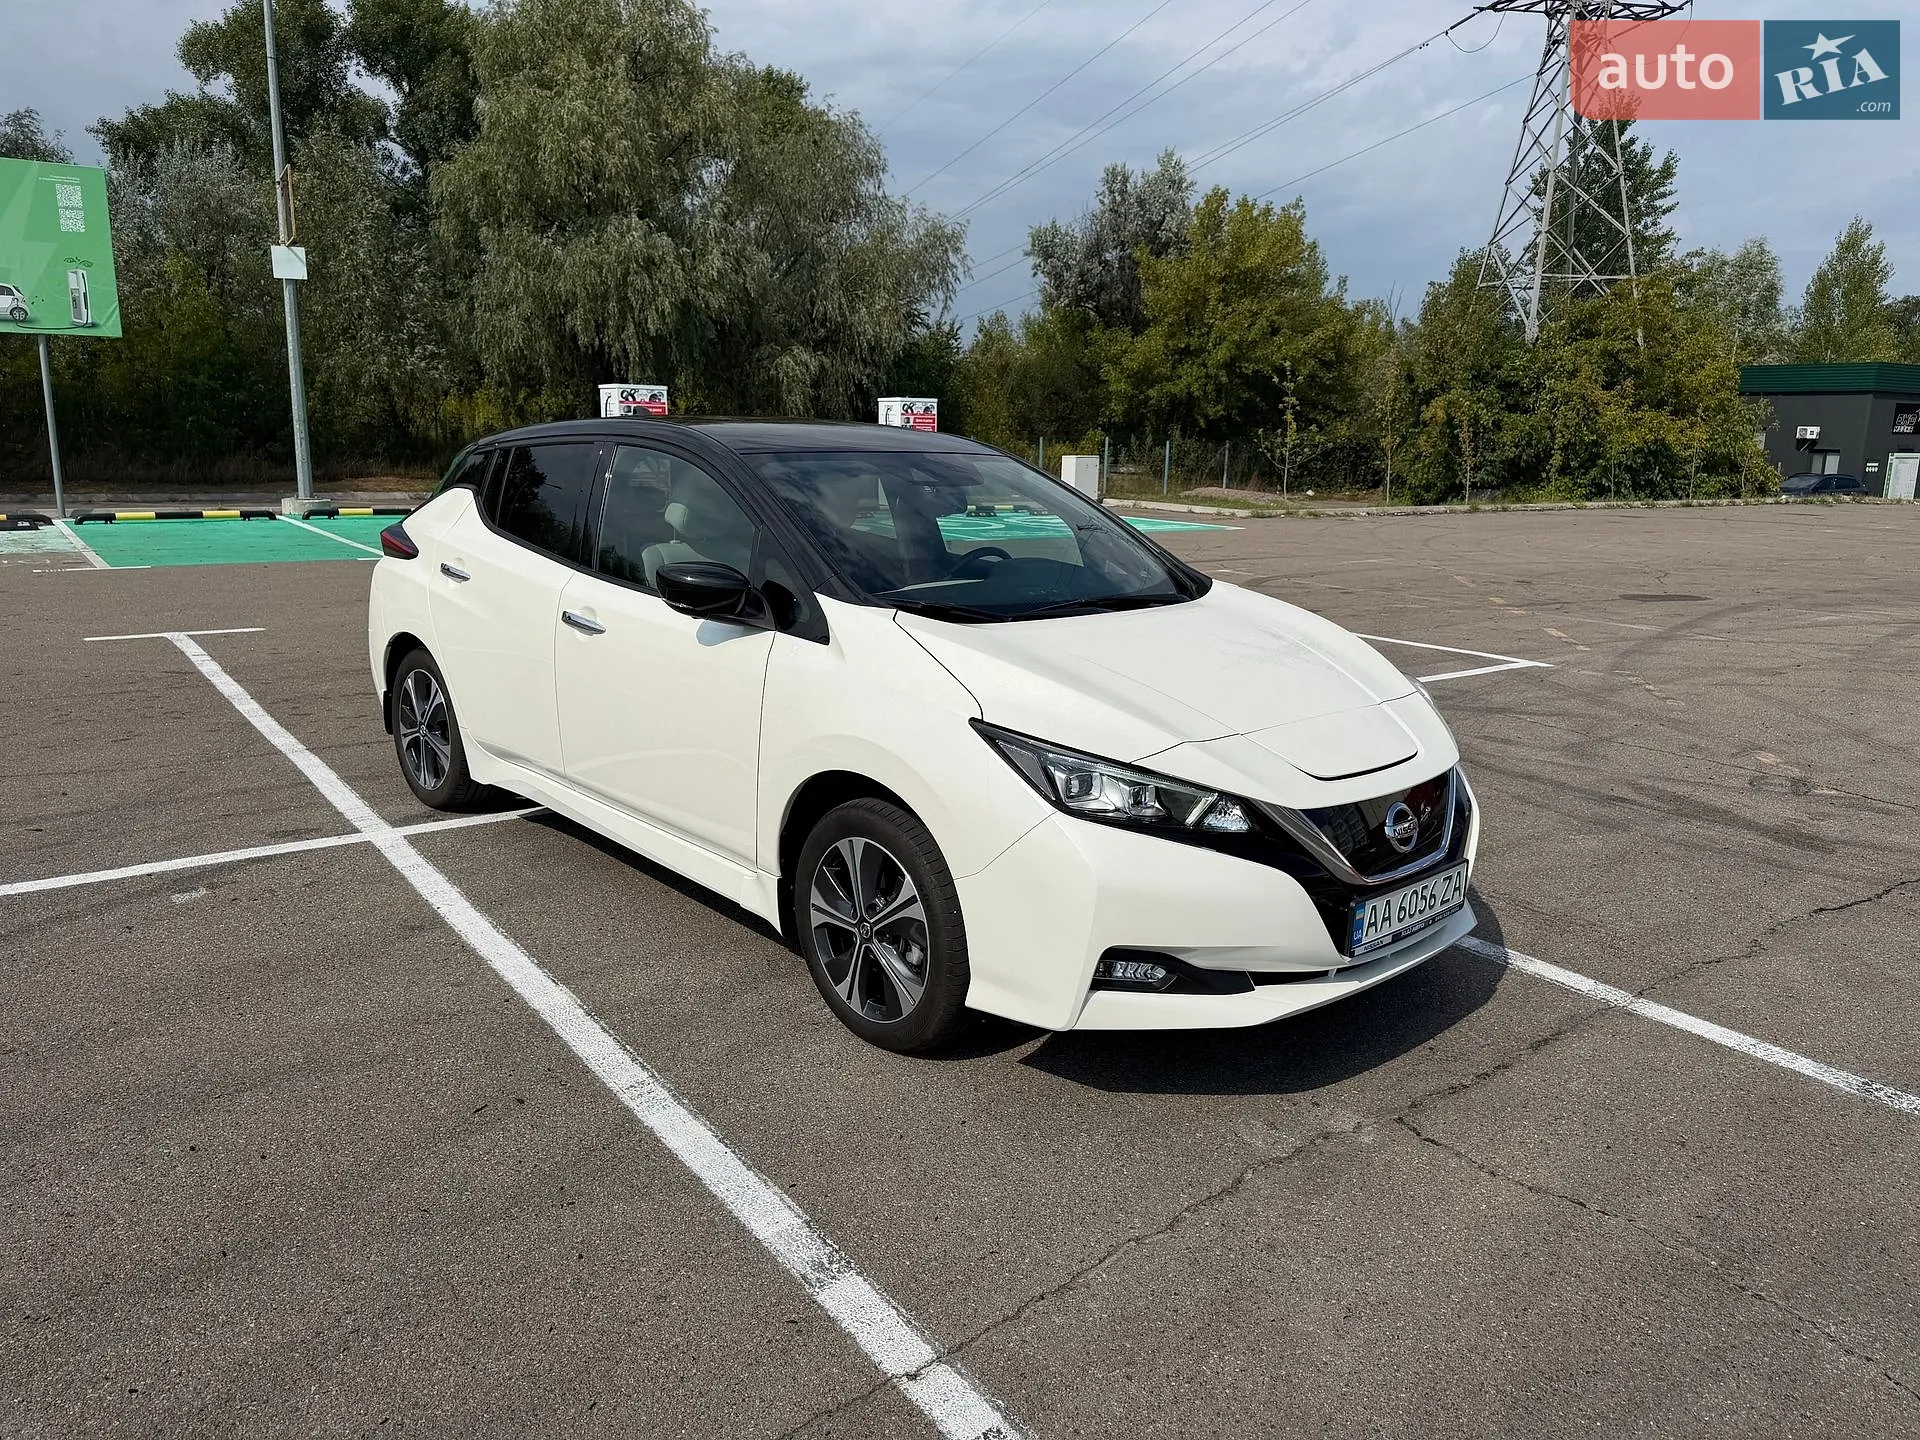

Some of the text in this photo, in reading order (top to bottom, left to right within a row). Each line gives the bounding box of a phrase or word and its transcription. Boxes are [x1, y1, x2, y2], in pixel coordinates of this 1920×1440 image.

[1365, 899, 1392, 937] AA
[1397, 880, 1437, 923] 6056
[1440, 871, 1462, 906] ZA
[1353, 930, 1363, 941] UA
